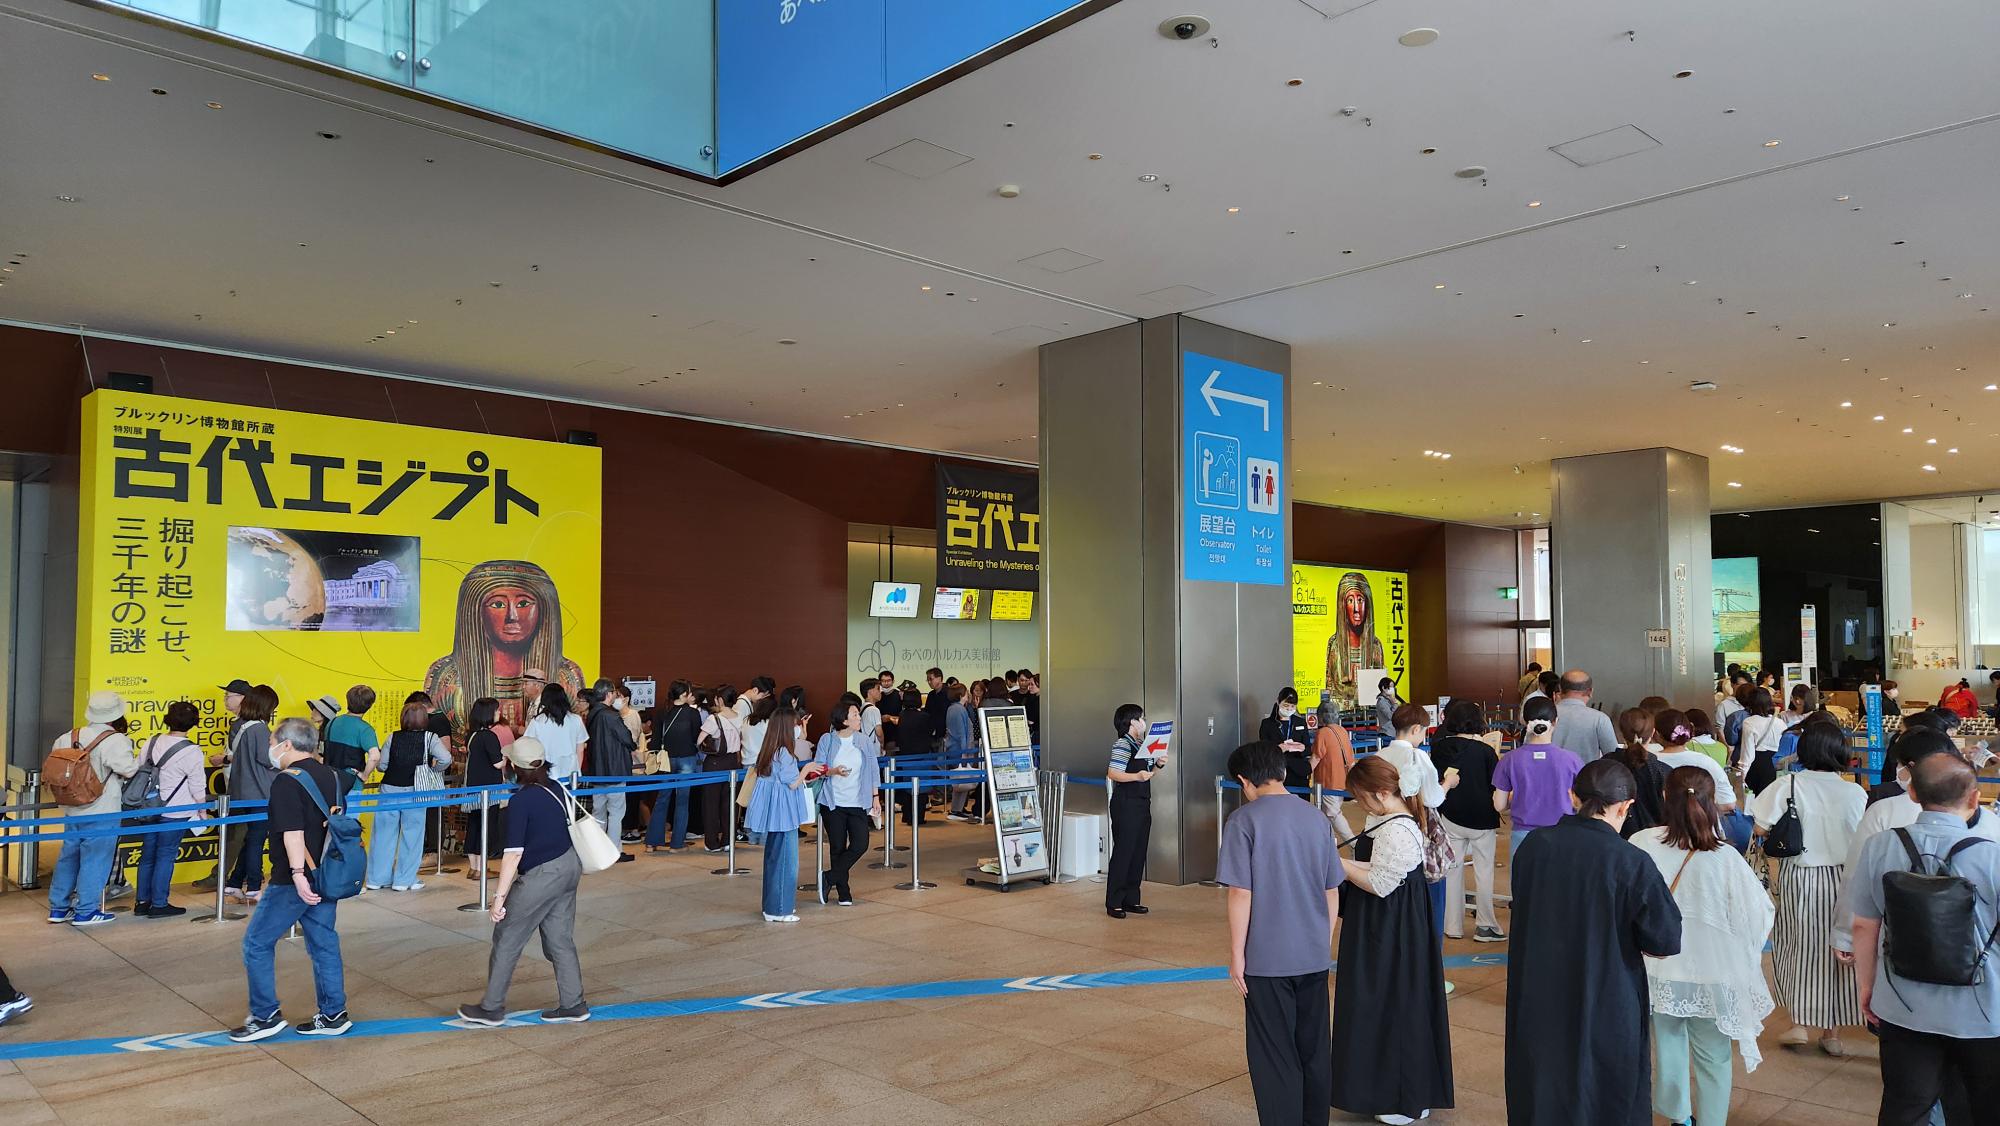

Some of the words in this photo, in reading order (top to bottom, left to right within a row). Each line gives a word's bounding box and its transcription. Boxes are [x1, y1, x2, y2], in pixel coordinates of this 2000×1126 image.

[114, 407, 275, 435] ブルックリン博物館所蔵
[114, 425, 143, 435] 特別展
[113, 428, 540, 525] 古代エジプト
[1200, 514, 1235, 535] 展望台
[1252, 525, 1275, 539] トイレ
[1200, 538, 1235, 551] Observatory
[1256, 544, 1272, 554] Toilet
[946, 557, 983, 570] Unraveling
[986, 560, 998, 569] the
[1000, 560, 1033, 572] Mysteries
[110, 517, 149, 655] 三千年の謎
[157, 517, 194, 661] 掘り起こせ、
[902, 648, 1001, 662] あべのハルカス美術館
